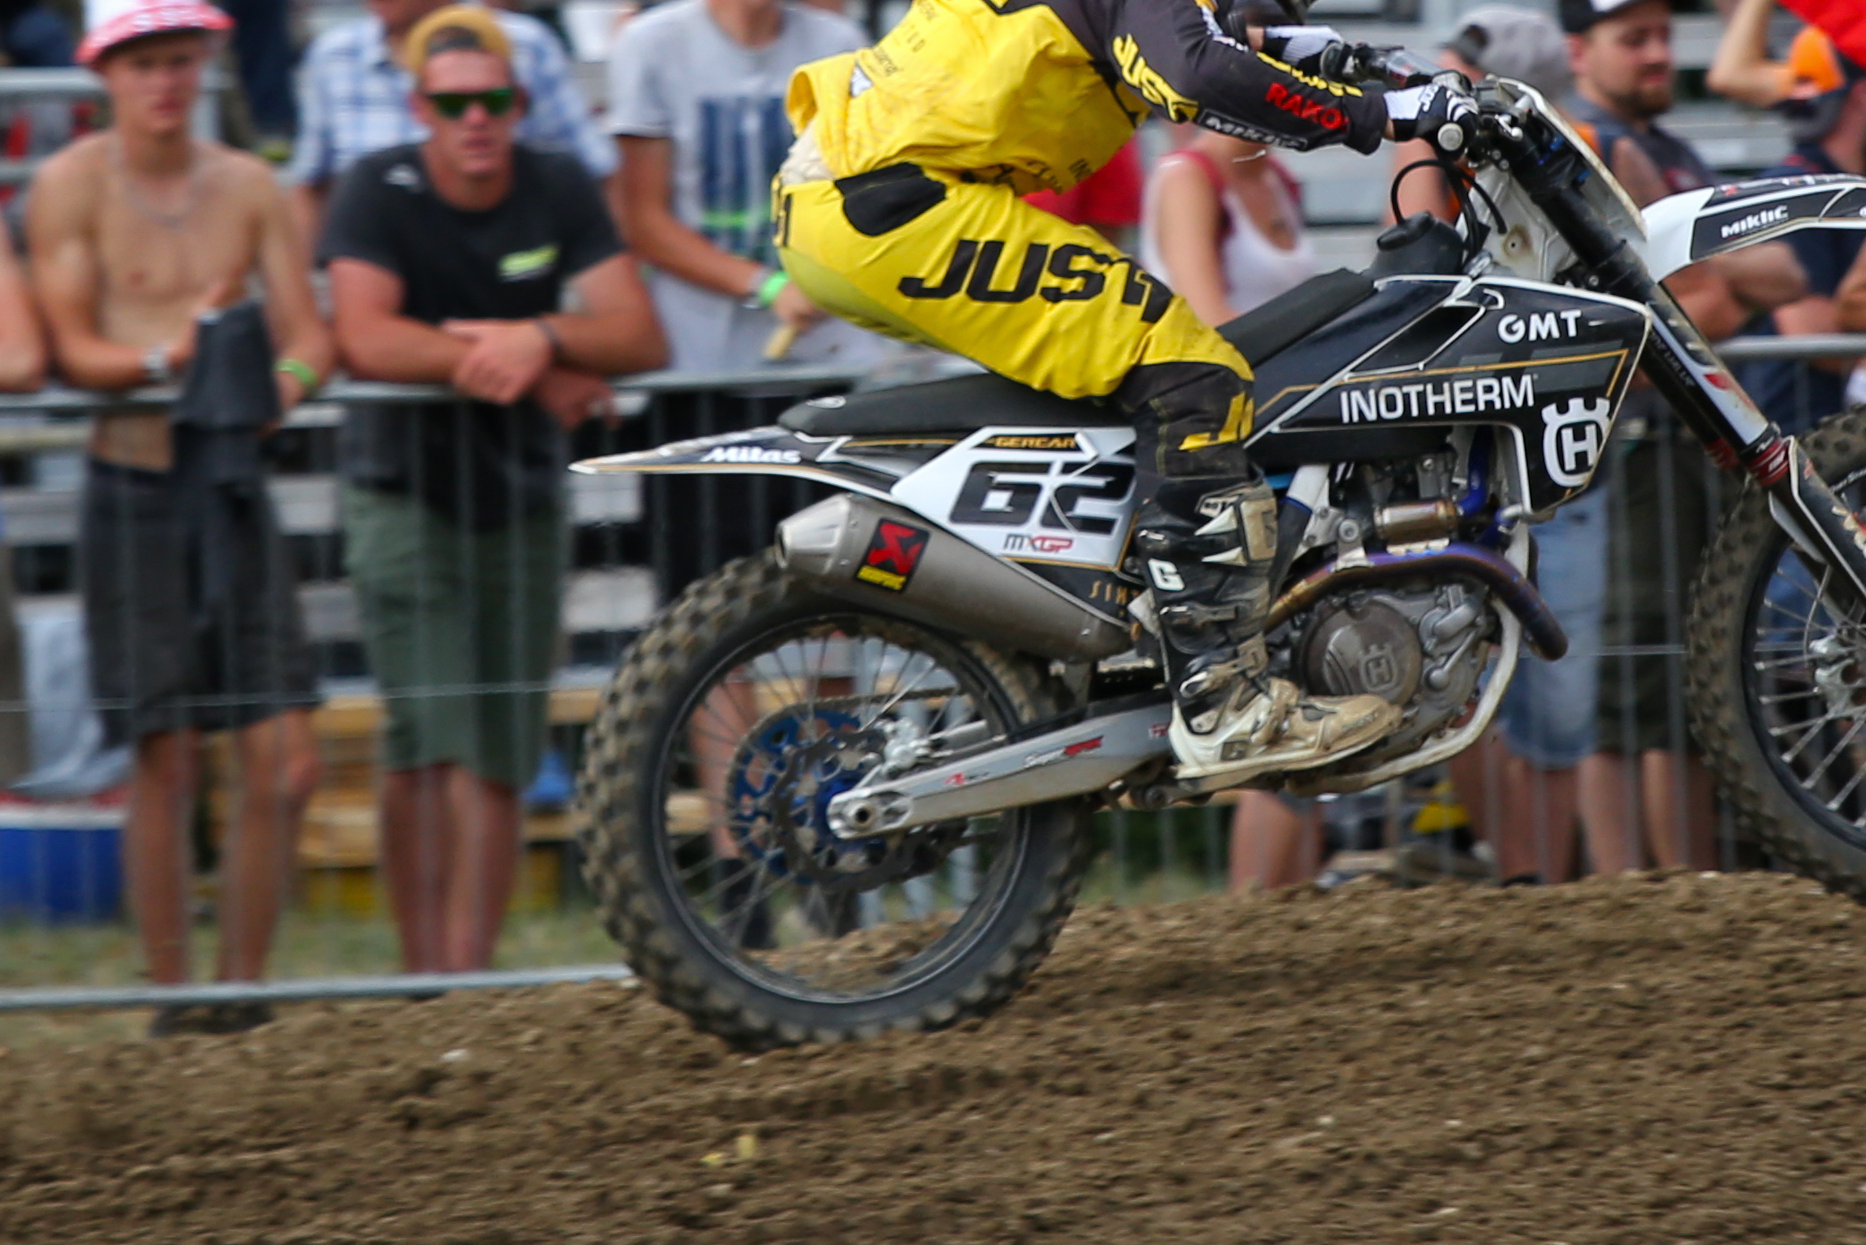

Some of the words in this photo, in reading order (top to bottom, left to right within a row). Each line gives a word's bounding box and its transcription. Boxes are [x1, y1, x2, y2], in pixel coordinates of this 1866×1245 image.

[1499, 309, 1582, 343] GMT
[1340, 375, 1534, 424] INOTHERM
[700, 446, 802, 464] Mitas
[995, 435, 1077, 449] GERCAR
[950, 461, 1136, 537] 62
[1003, 533, 1075, 553] MXGP
